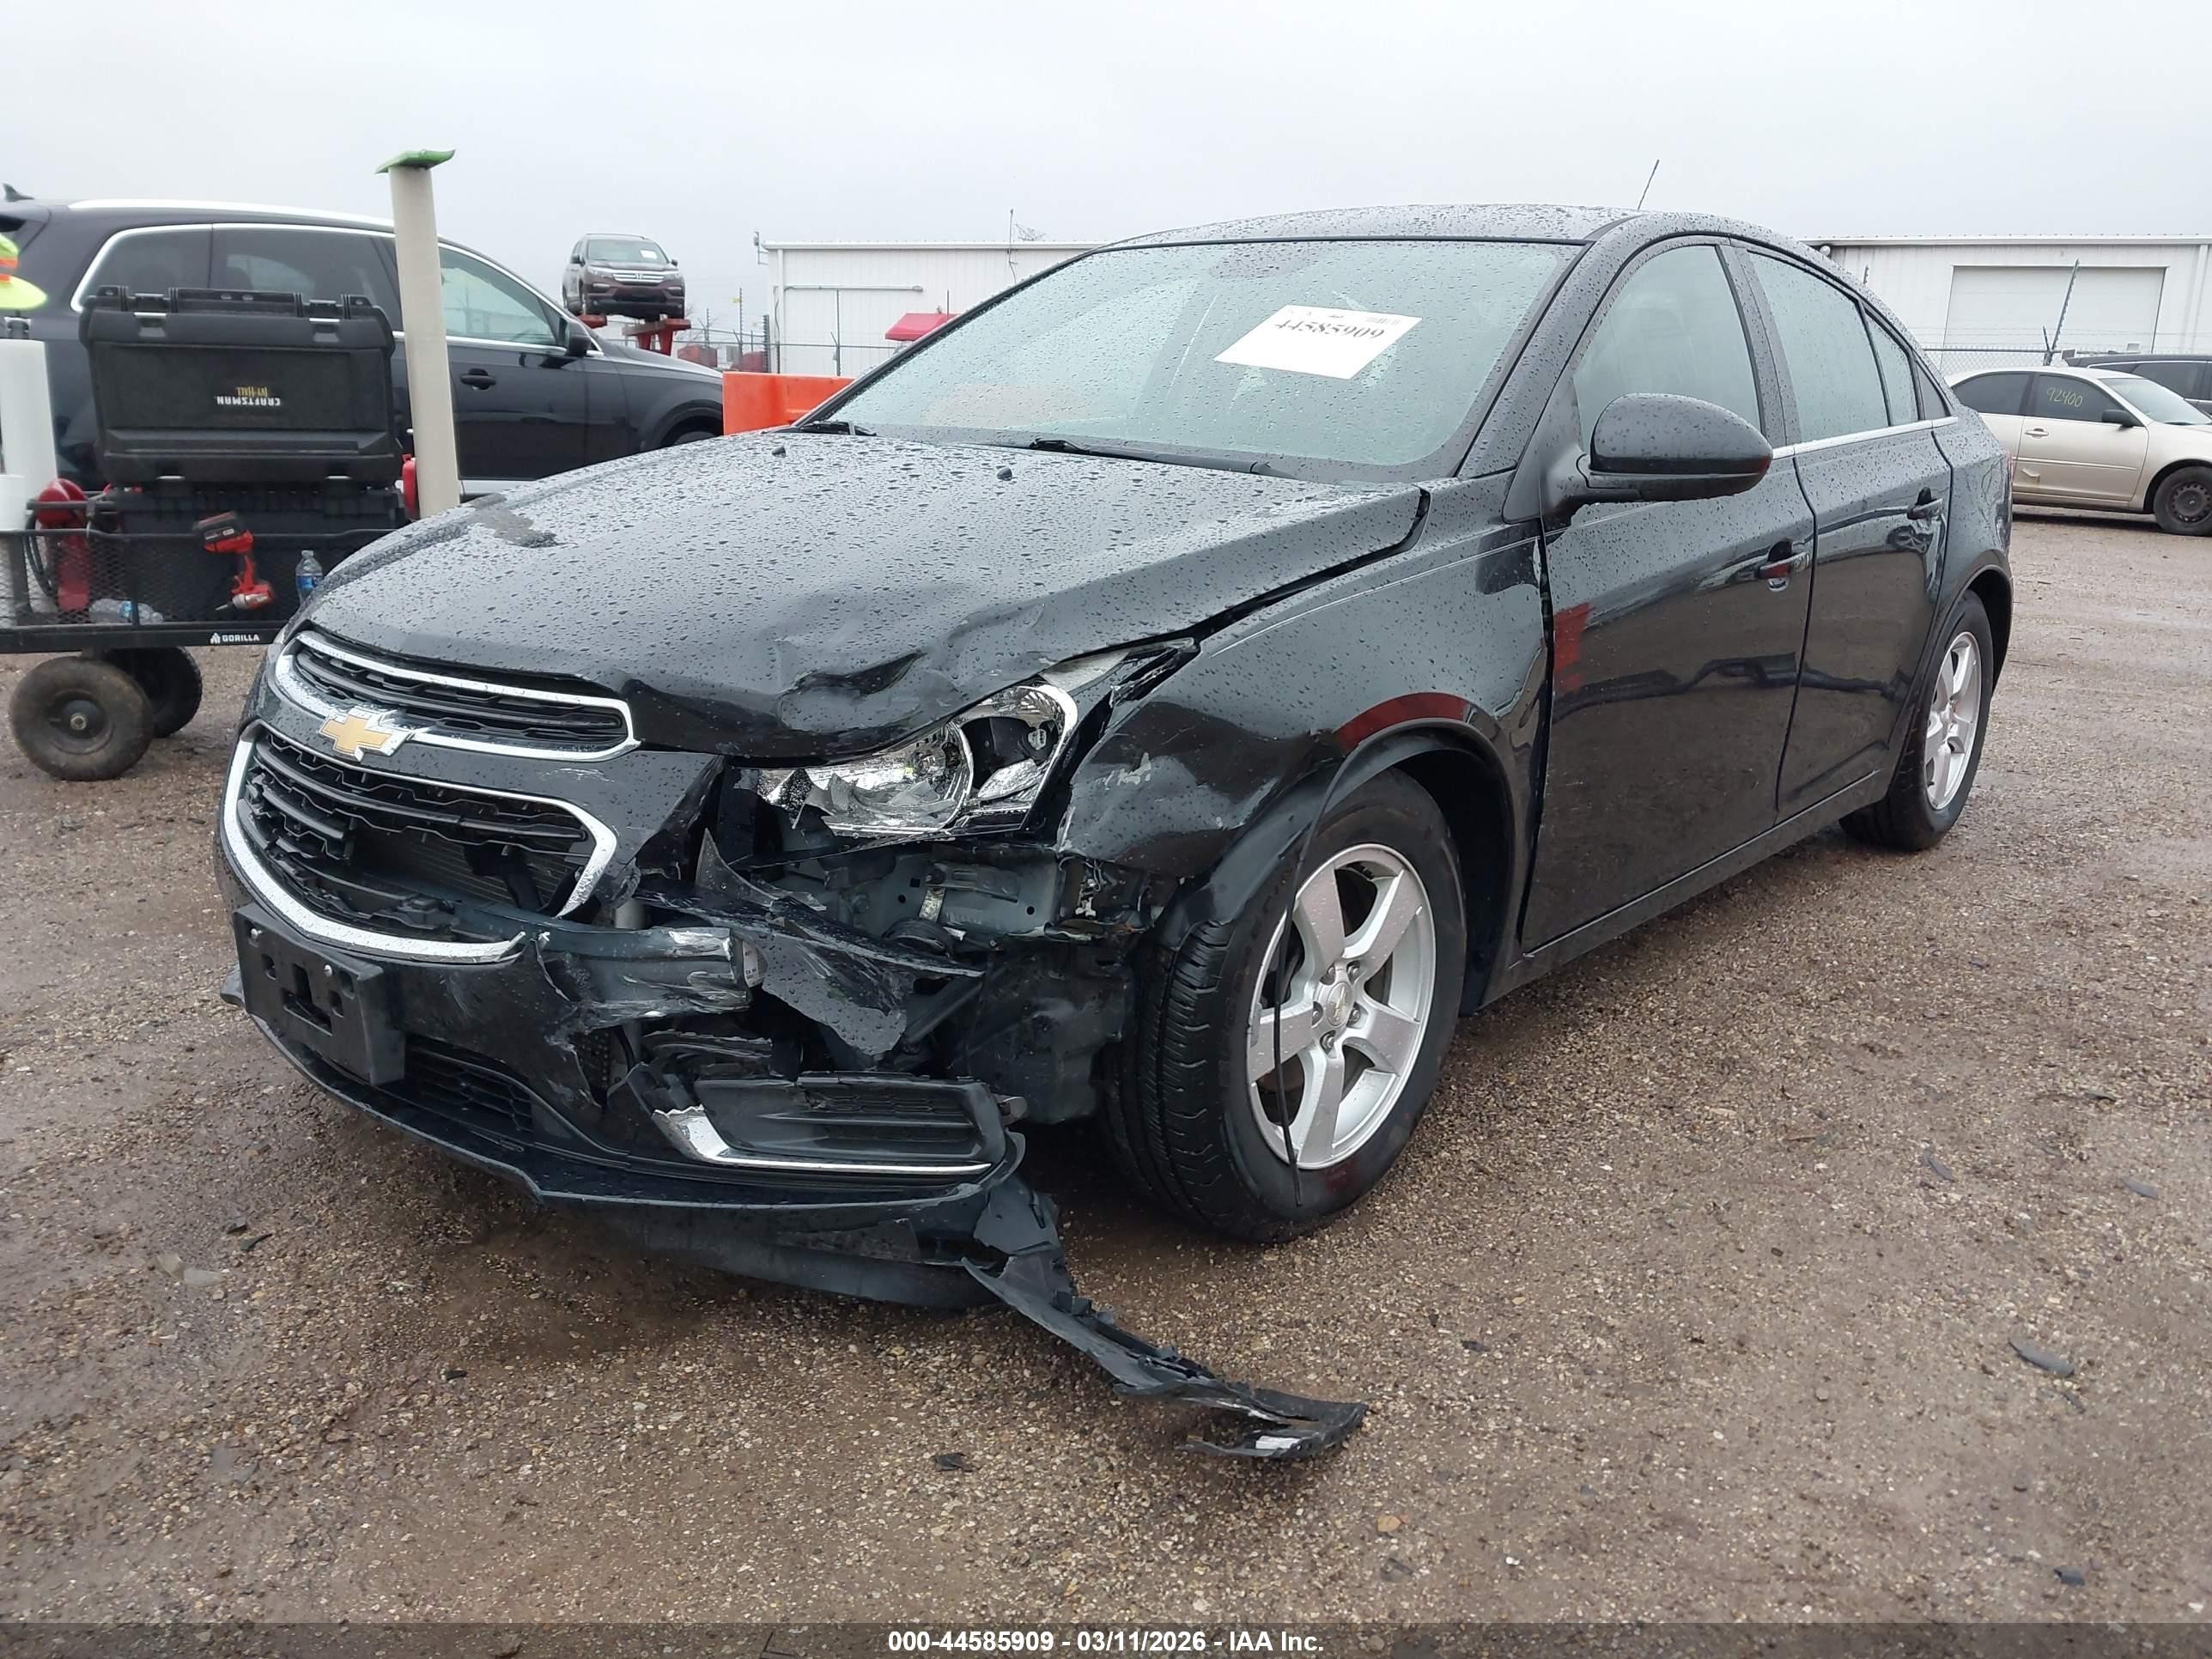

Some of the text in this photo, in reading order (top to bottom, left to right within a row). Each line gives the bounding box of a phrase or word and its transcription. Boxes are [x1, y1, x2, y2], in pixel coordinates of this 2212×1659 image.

[1274, 319, 1385, 339] 44585909
[216, 395, 282, 407] CRAFTSMAN
[2046, 387, 2083, 408] 92400
[222, 634, 260, 642] GORILLA
